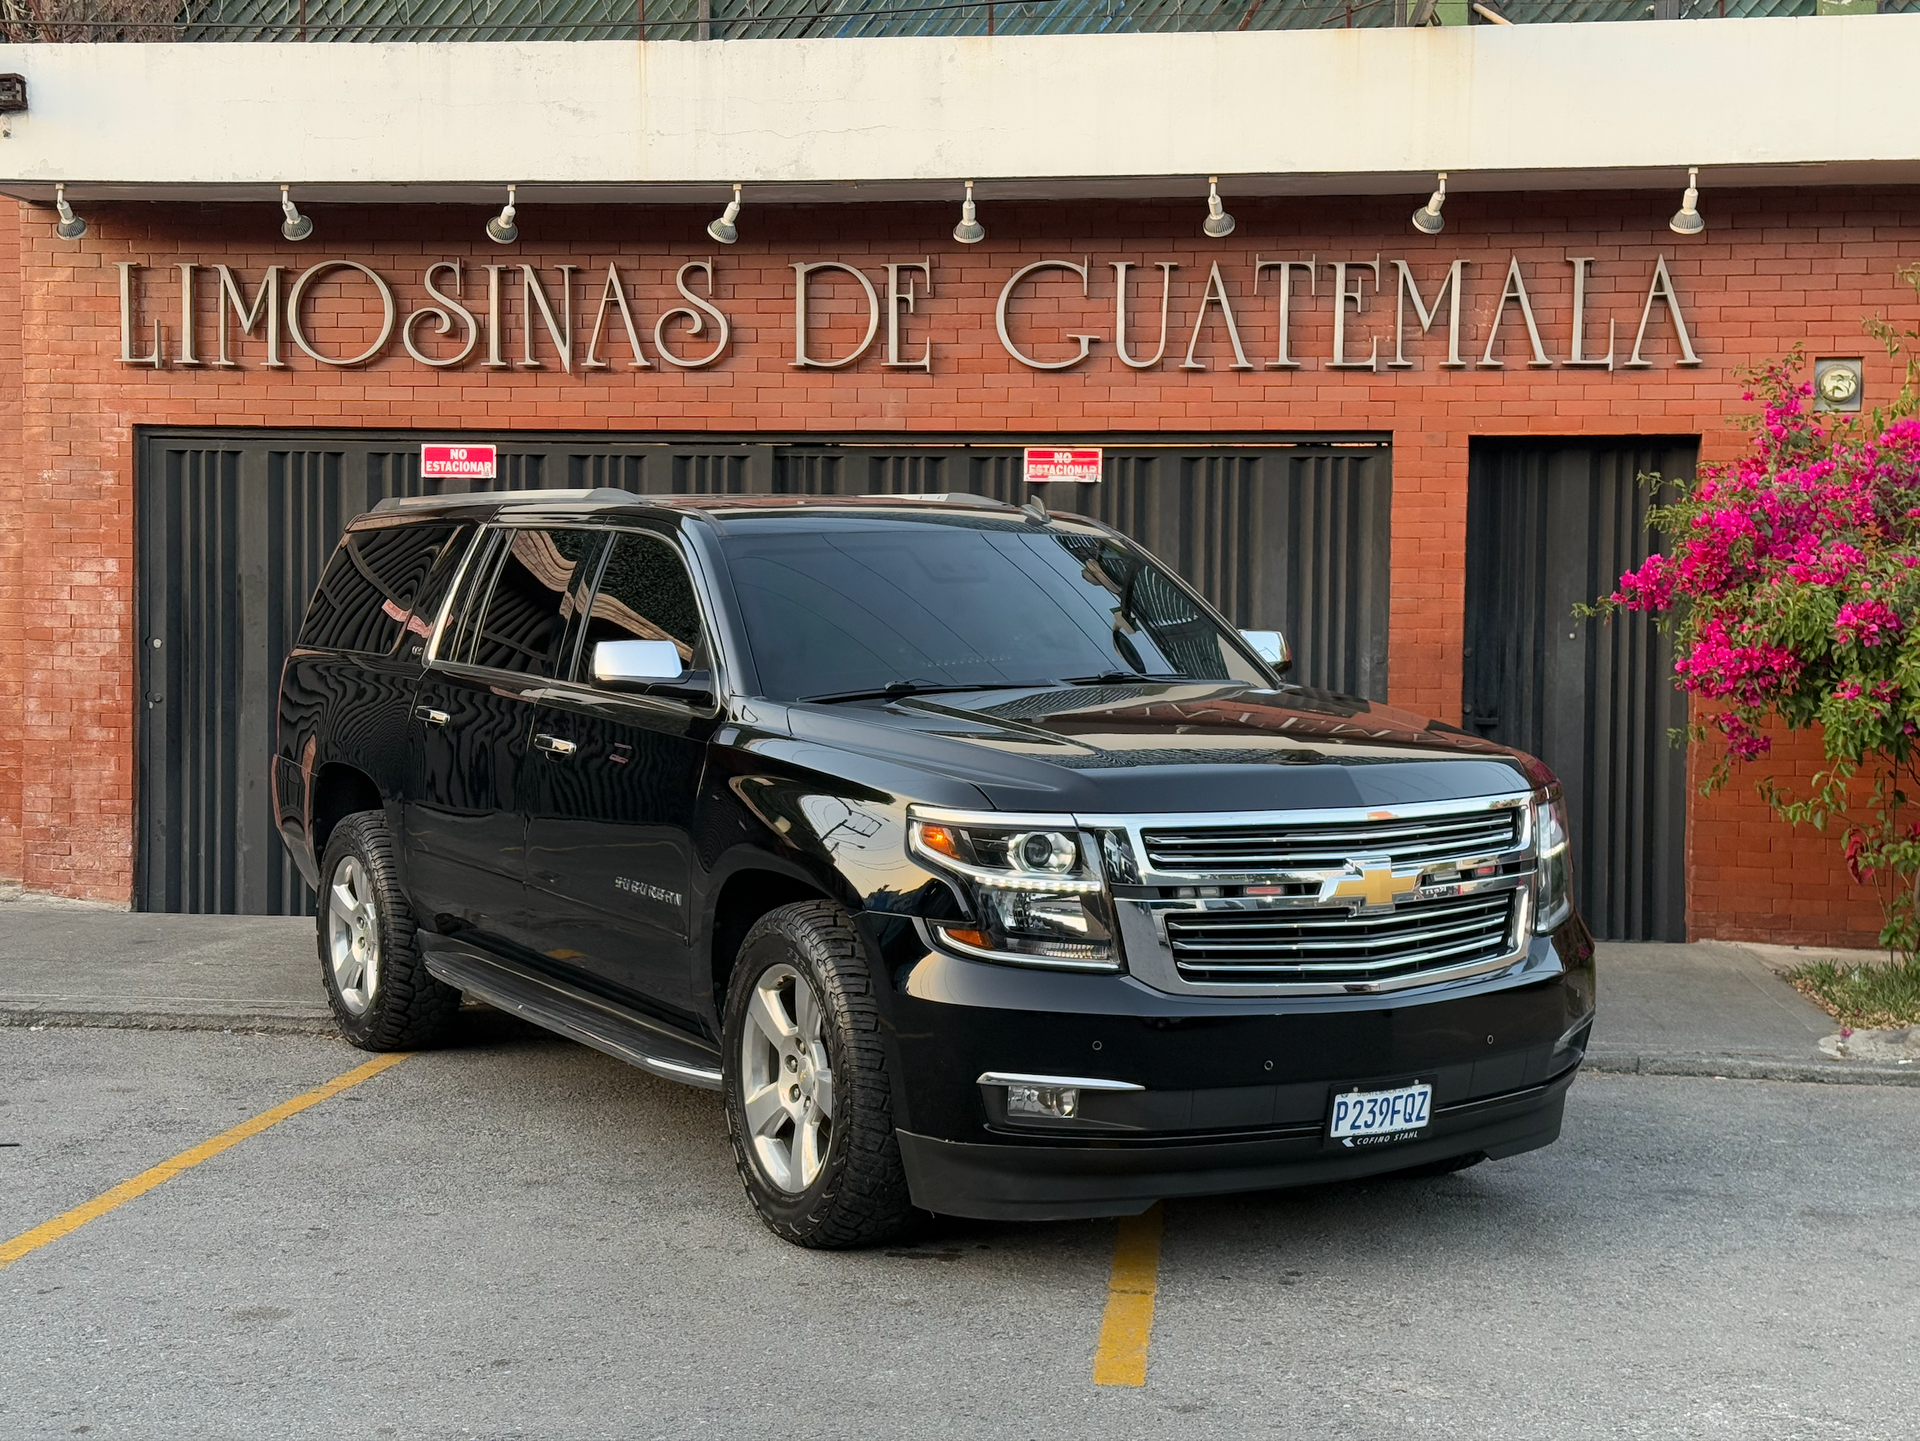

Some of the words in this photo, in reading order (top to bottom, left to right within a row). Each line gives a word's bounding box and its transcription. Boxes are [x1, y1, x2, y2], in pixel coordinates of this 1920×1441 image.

[112, 256, 731, 375] LIMOSINAS
[787, 254, 931, 374] DE
[995, 252, 1703, 373] GUATEMALA
[449, 448, 468, 460] NO
[1053, 451, 1073, 464] NO
[425, 460, 493, 473] ESTACIONAR
[1028, 464, 1098, 476] ESTACIONAR
[614, 875, 683, 907] SUBURBAN
[1333, 1090, 1429, 1132] P239FQZ
[1393, 1130, 1418, 1141] STAHL
